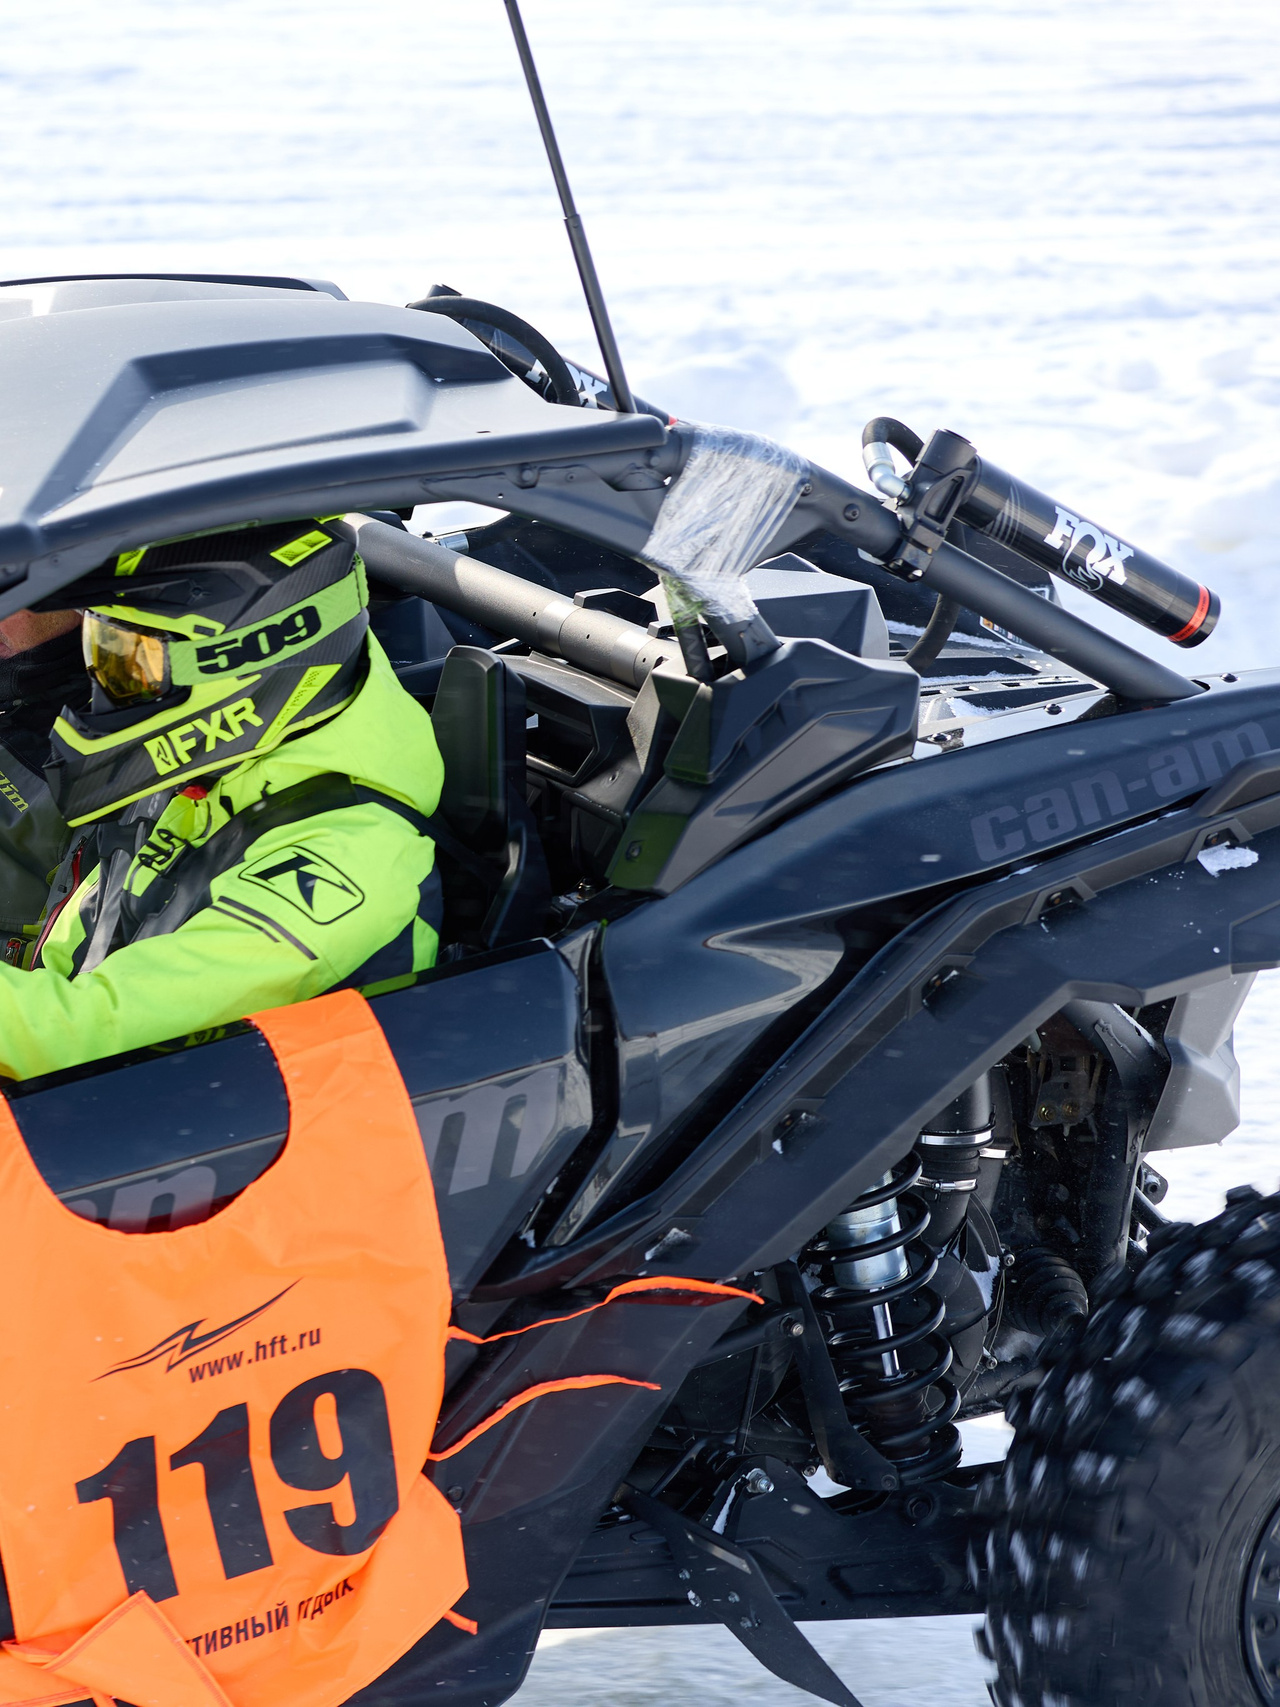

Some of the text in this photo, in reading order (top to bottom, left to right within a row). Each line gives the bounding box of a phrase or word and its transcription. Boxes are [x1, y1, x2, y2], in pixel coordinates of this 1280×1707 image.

[1043, 505, 1135, 590] FOX
[196, 605, 322, 674] 509
[167, 697, 264, 764] FXR
[970, 722, 1270, 862] can-am
[188, 1327, 322, 1383] www.hft.ru
[75, 1368, 400, 1604] 119
